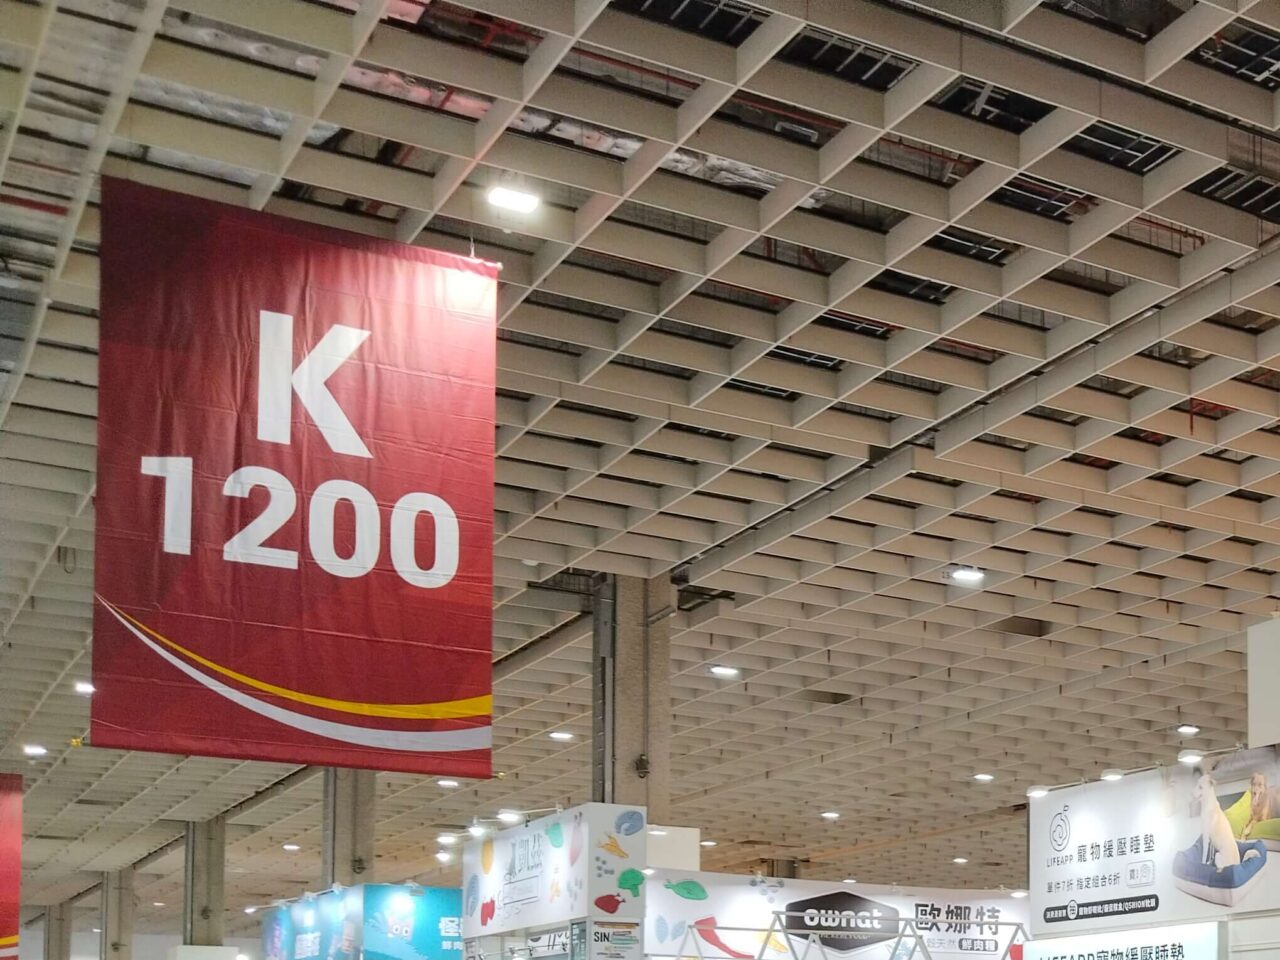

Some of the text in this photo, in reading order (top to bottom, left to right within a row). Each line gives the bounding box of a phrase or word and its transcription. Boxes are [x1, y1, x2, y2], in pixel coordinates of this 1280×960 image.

[257, 310, 373, 459] K
[141, 456, 460, 588] 1200
[1046, 855, 1074, 868] LIFEAPP
[804, 907, 882, 929] ownat
[914, 903, 1001, 937] 歐娜特
